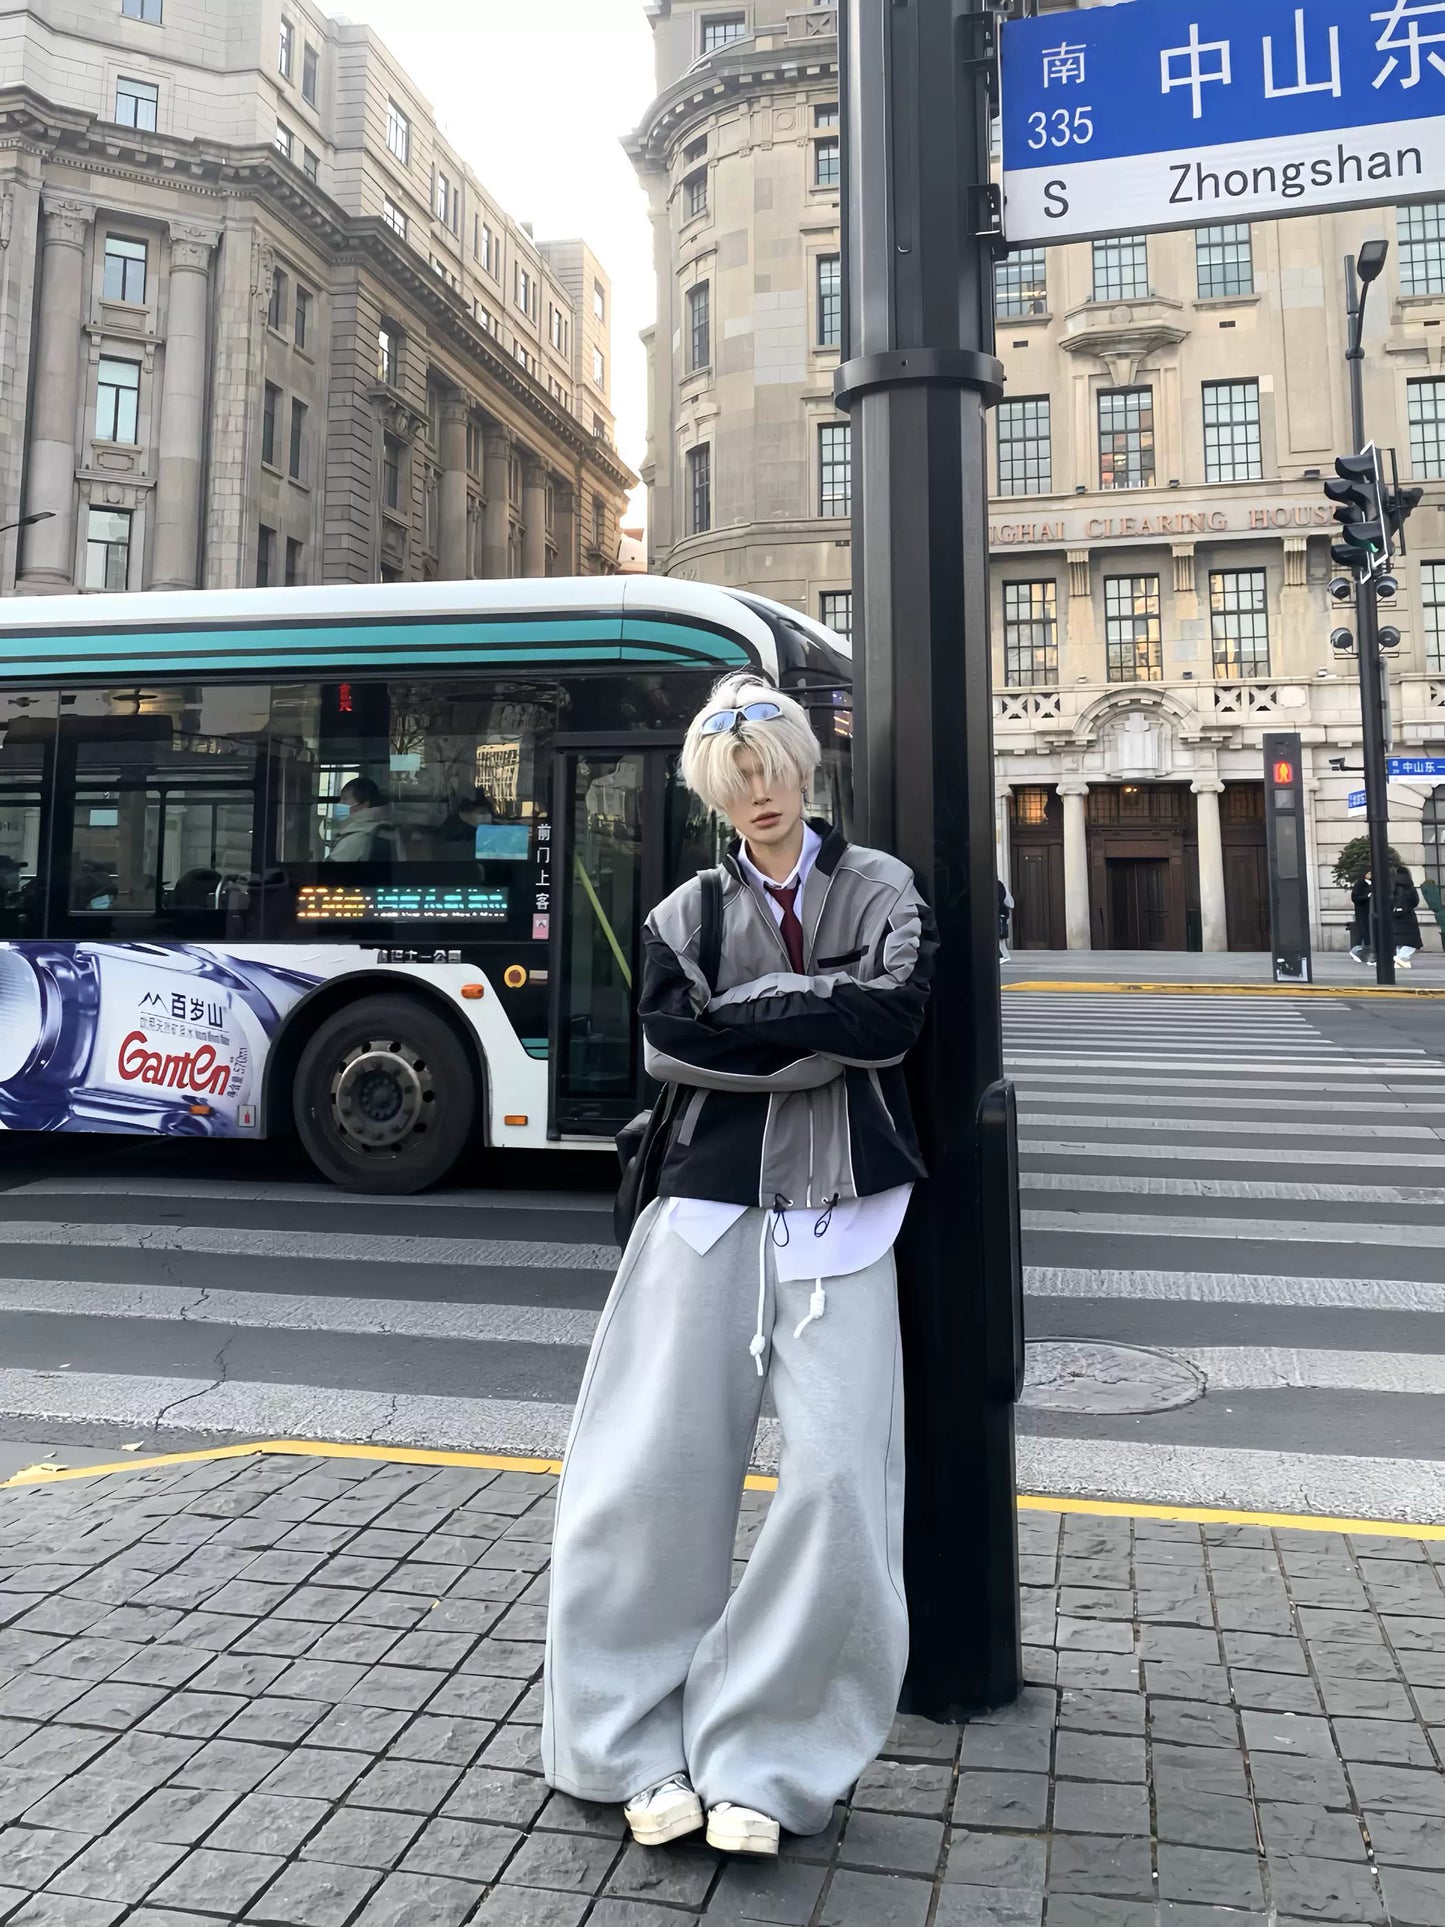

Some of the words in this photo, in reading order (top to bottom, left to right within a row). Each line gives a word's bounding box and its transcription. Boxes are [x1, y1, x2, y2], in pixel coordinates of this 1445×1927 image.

[1041, 41, 1087, 89] 南
[1160, 0, 1445, 119] 中山东
[1027, 106, 1094, 150] 335
[1043, 180, 1069, 219] S
[1169, 144, 1423, 204] Zhongshan
[1086, 511, 1228, 540] CLEARING
[535, 823, 552, 910] 前门上客
[171, 992, 223, 1028] 百岁山
